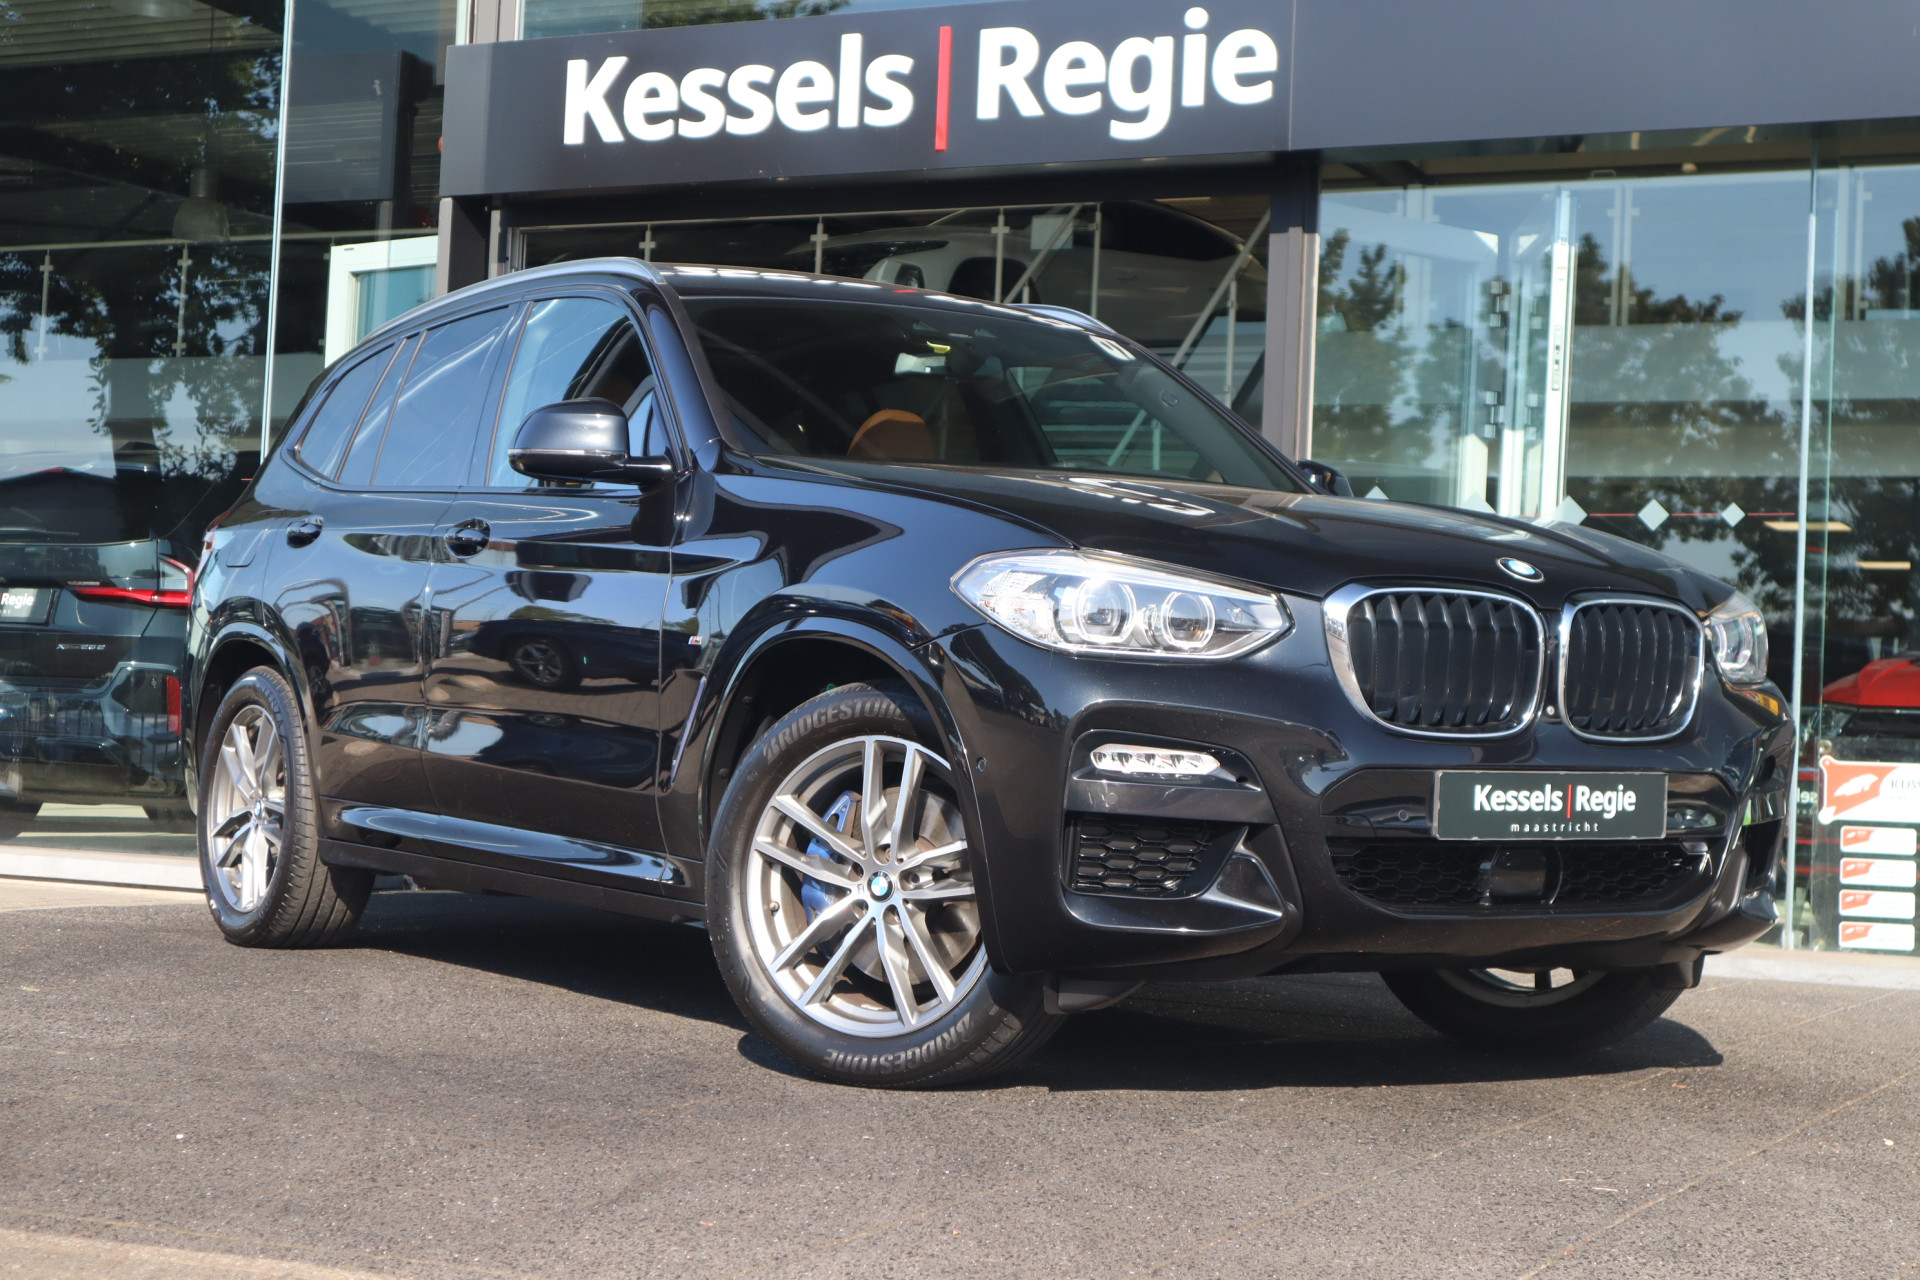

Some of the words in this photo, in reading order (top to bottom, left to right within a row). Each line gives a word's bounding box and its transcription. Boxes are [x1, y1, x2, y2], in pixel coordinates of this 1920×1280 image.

[563, 33, 914, 146] Kessels
[976, 7, 1278, 141] Regie
[1, 592, 34, 609] Regie
[1473, 783, 1563, 812] Kessels
[1575, 784, 1637, 820] Regie
[1510, 821, 1599, 833] maastricht
[824, 1011, 977, 1075] BRIDGESTONE
